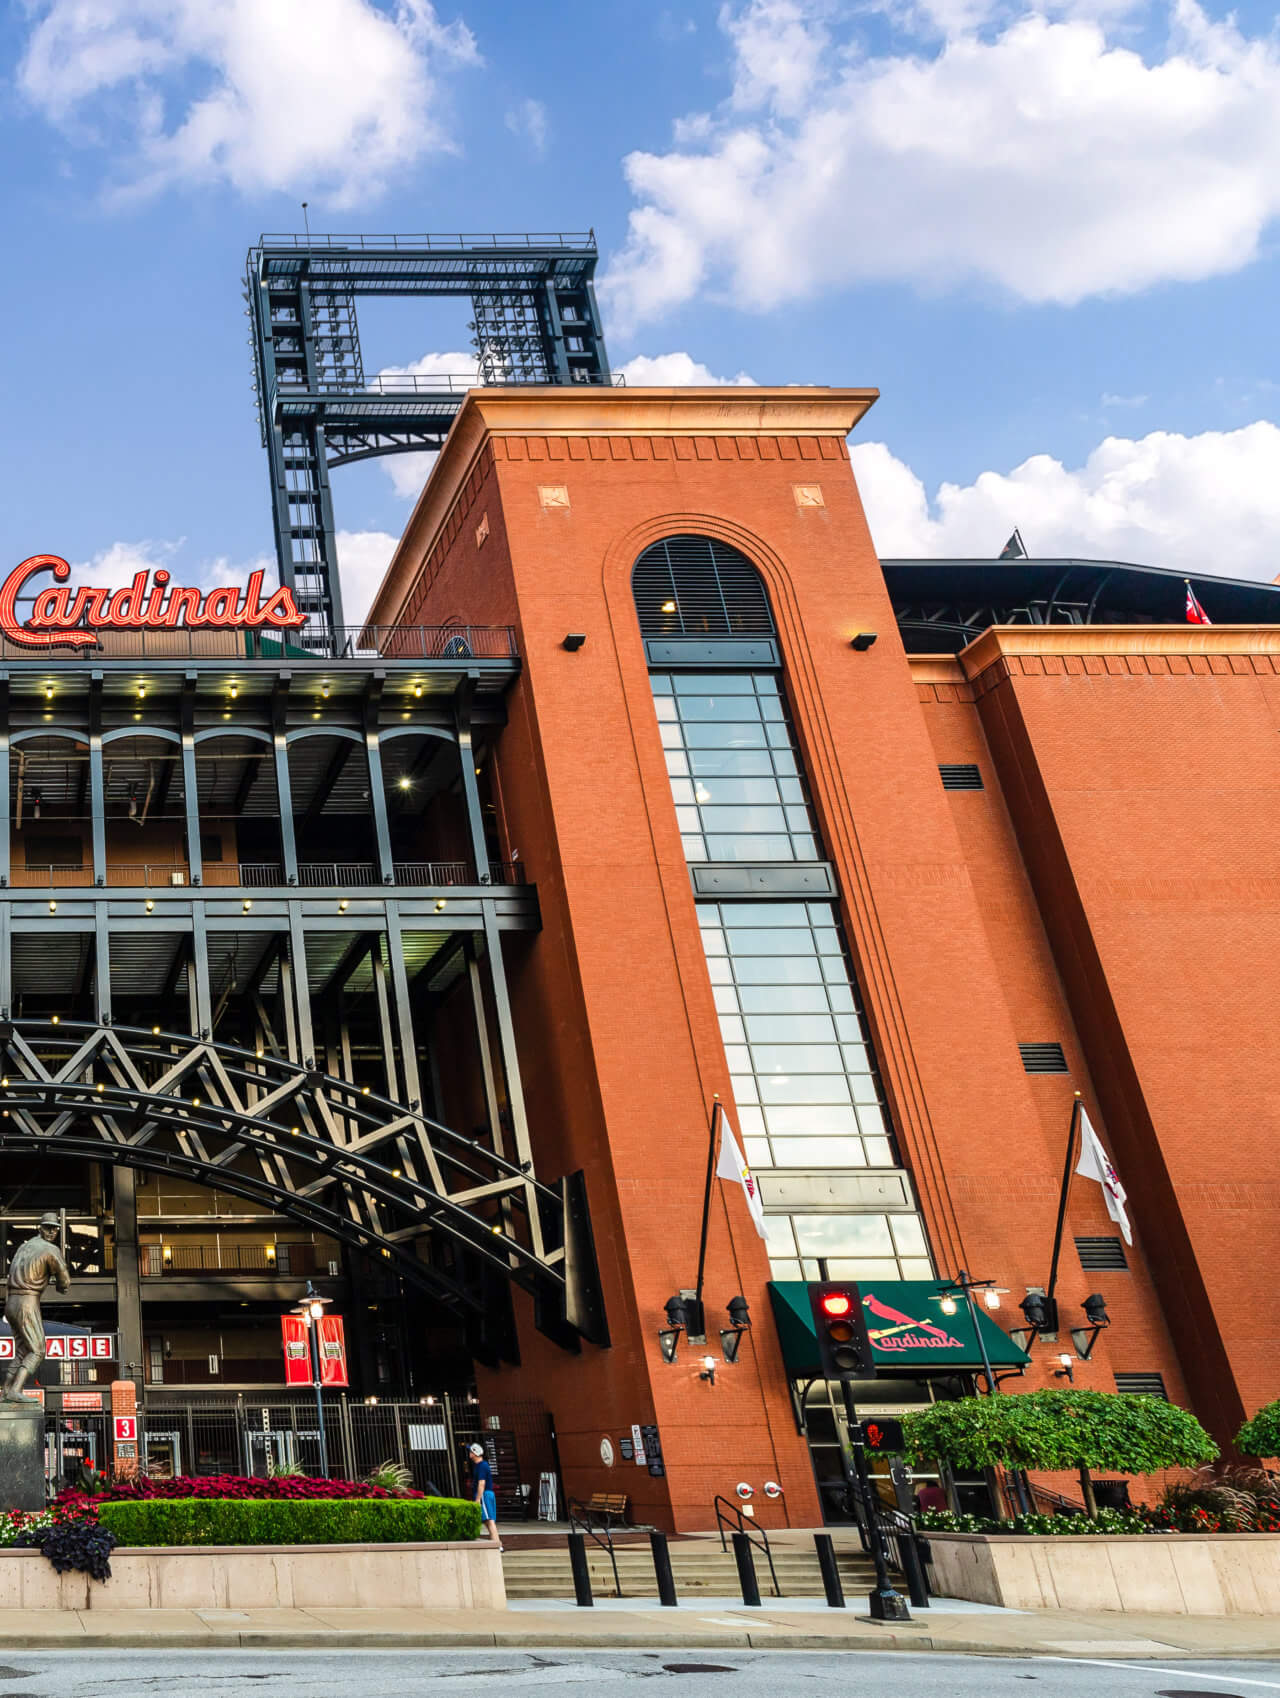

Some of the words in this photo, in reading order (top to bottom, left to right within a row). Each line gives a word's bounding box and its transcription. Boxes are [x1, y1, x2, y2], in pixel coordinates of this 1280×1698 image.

[47, 1338, 107, 1356] ASE
[867, 1329, 964, 1352] Cardinals
[121, 1420, 130, 1437] 3
